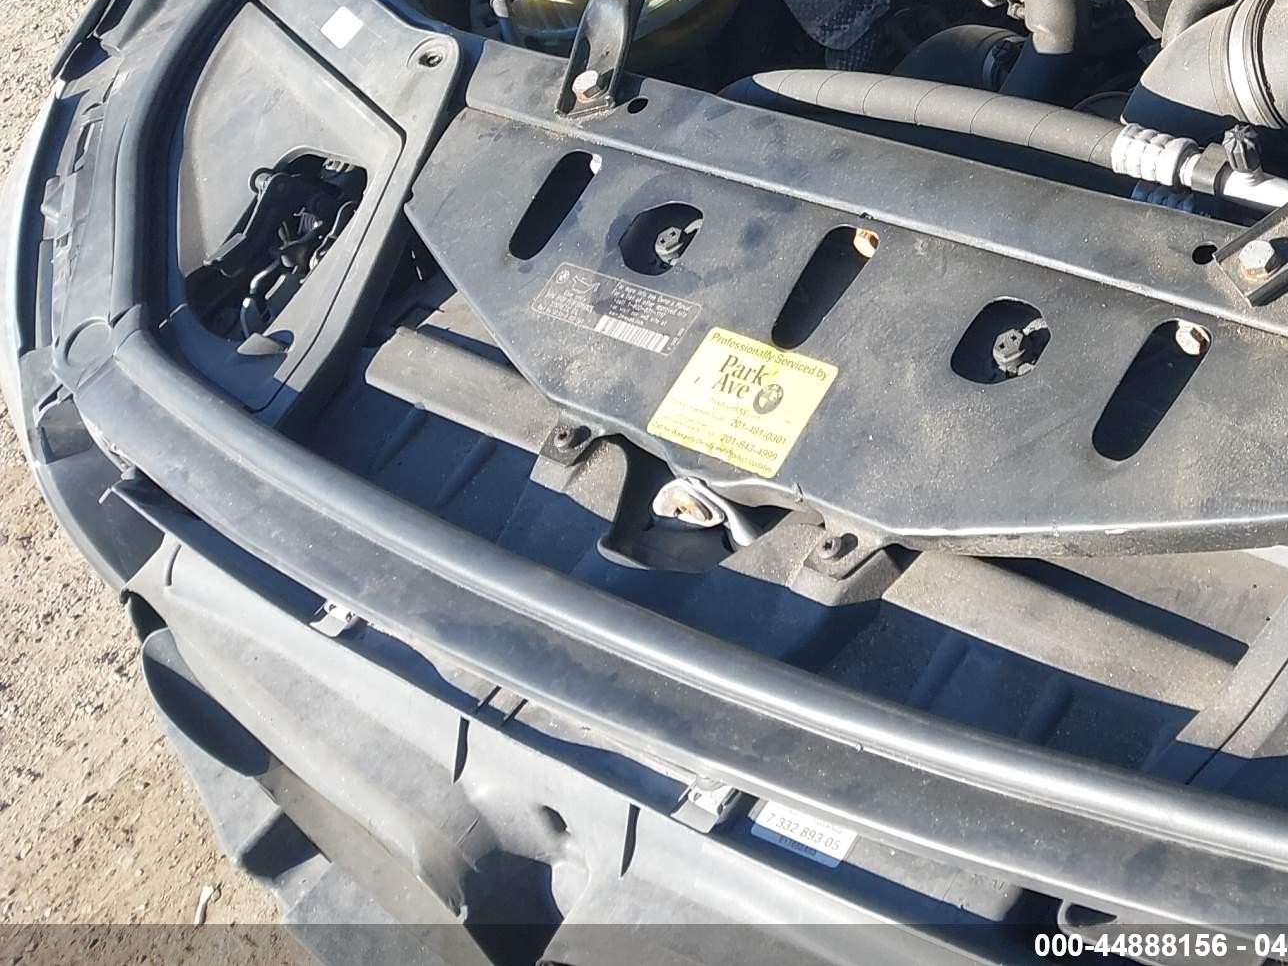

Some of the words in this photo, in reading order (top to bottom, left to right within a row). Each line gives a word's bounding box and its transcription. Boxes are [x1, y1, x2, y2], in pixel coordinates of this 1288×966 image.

[711, 332, 776, 363] Professionally
[775, 353, 818, 377] Serviced
[816, 368, 831, 382] by
[719, 354, 769, 387] Park
[711, 373, 750, 400] Ave
[776, 817, 799, 834] 332
[800, 826, 823, 845] 893
[824, 836, 841, 852] 05
